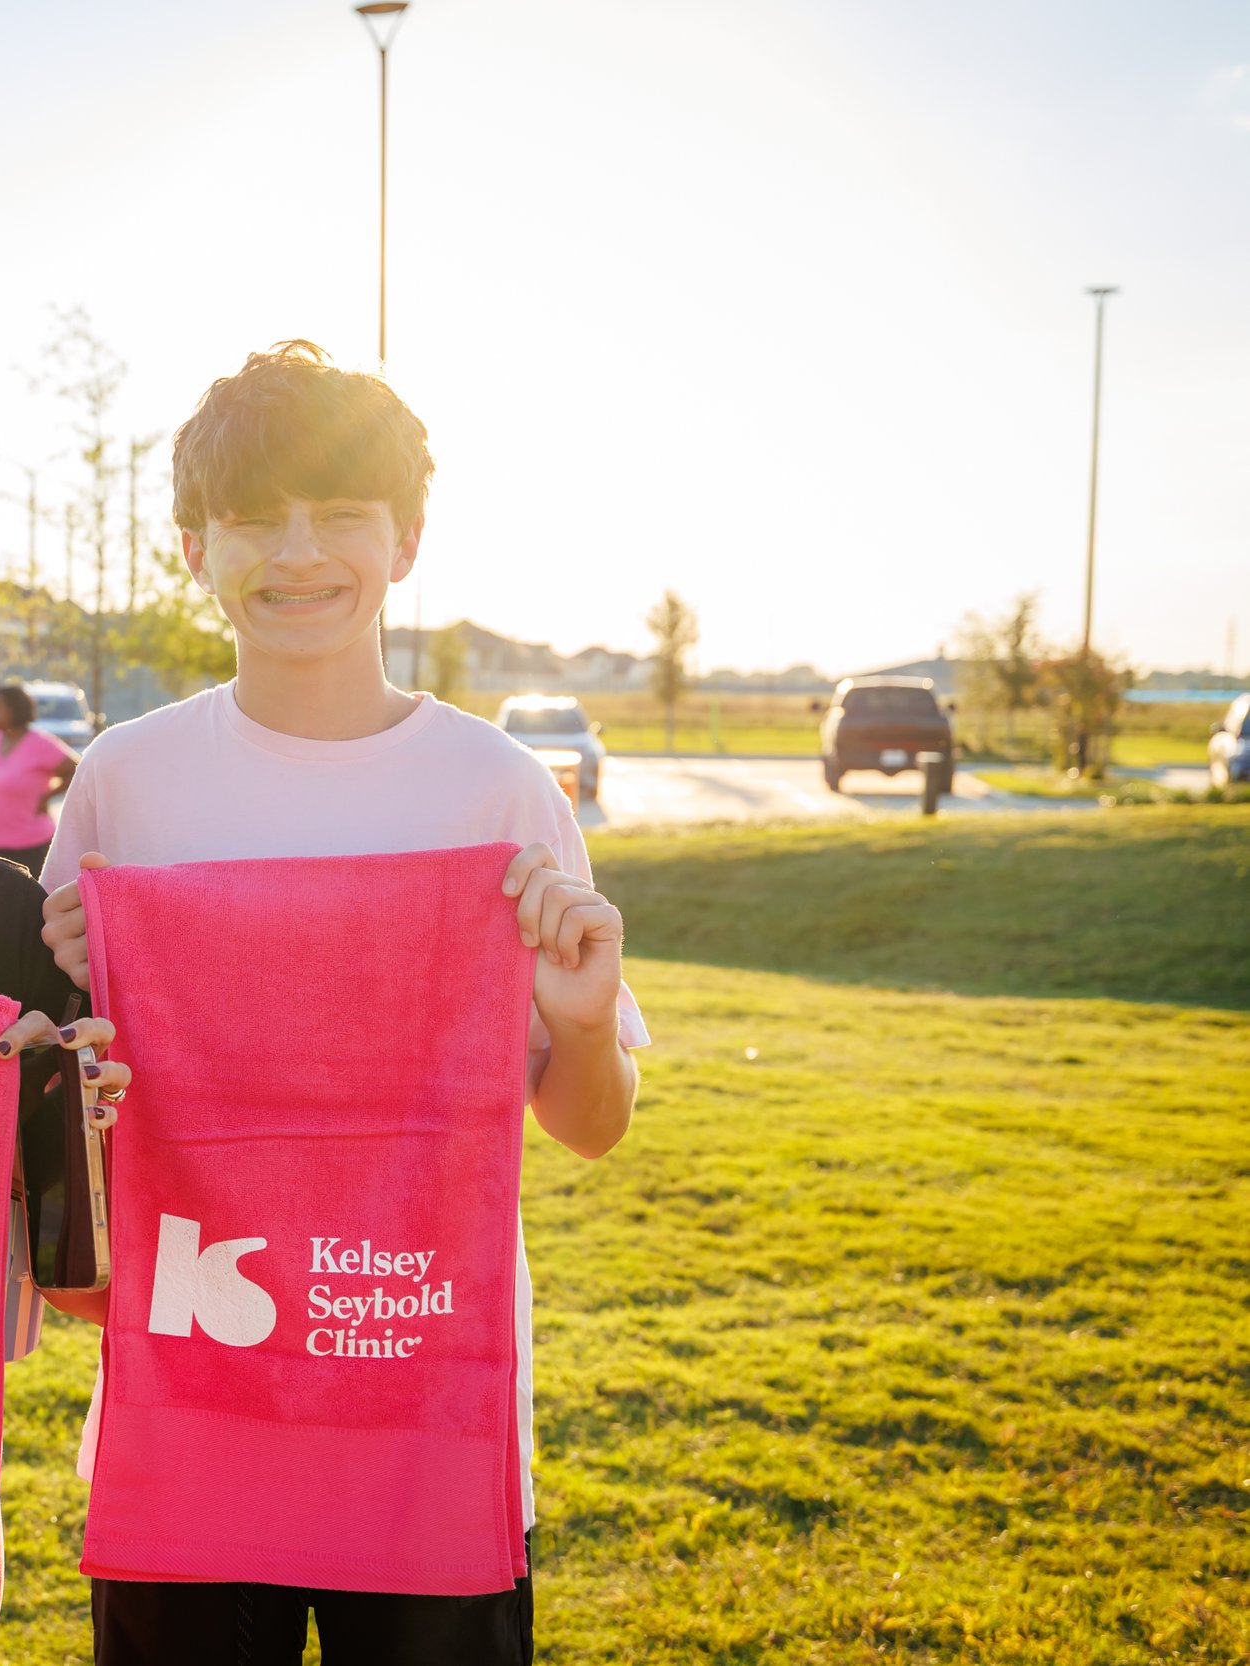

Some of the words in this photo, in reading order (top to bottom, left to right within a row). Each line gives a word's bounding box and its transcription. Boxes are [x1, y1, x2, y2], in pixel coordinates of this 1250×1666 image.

[308, 1236, 438, 1283] Kelsey
[307, 1280, 455, 1327] Seybold
[305, 1327, 422, 1359] Clinic
